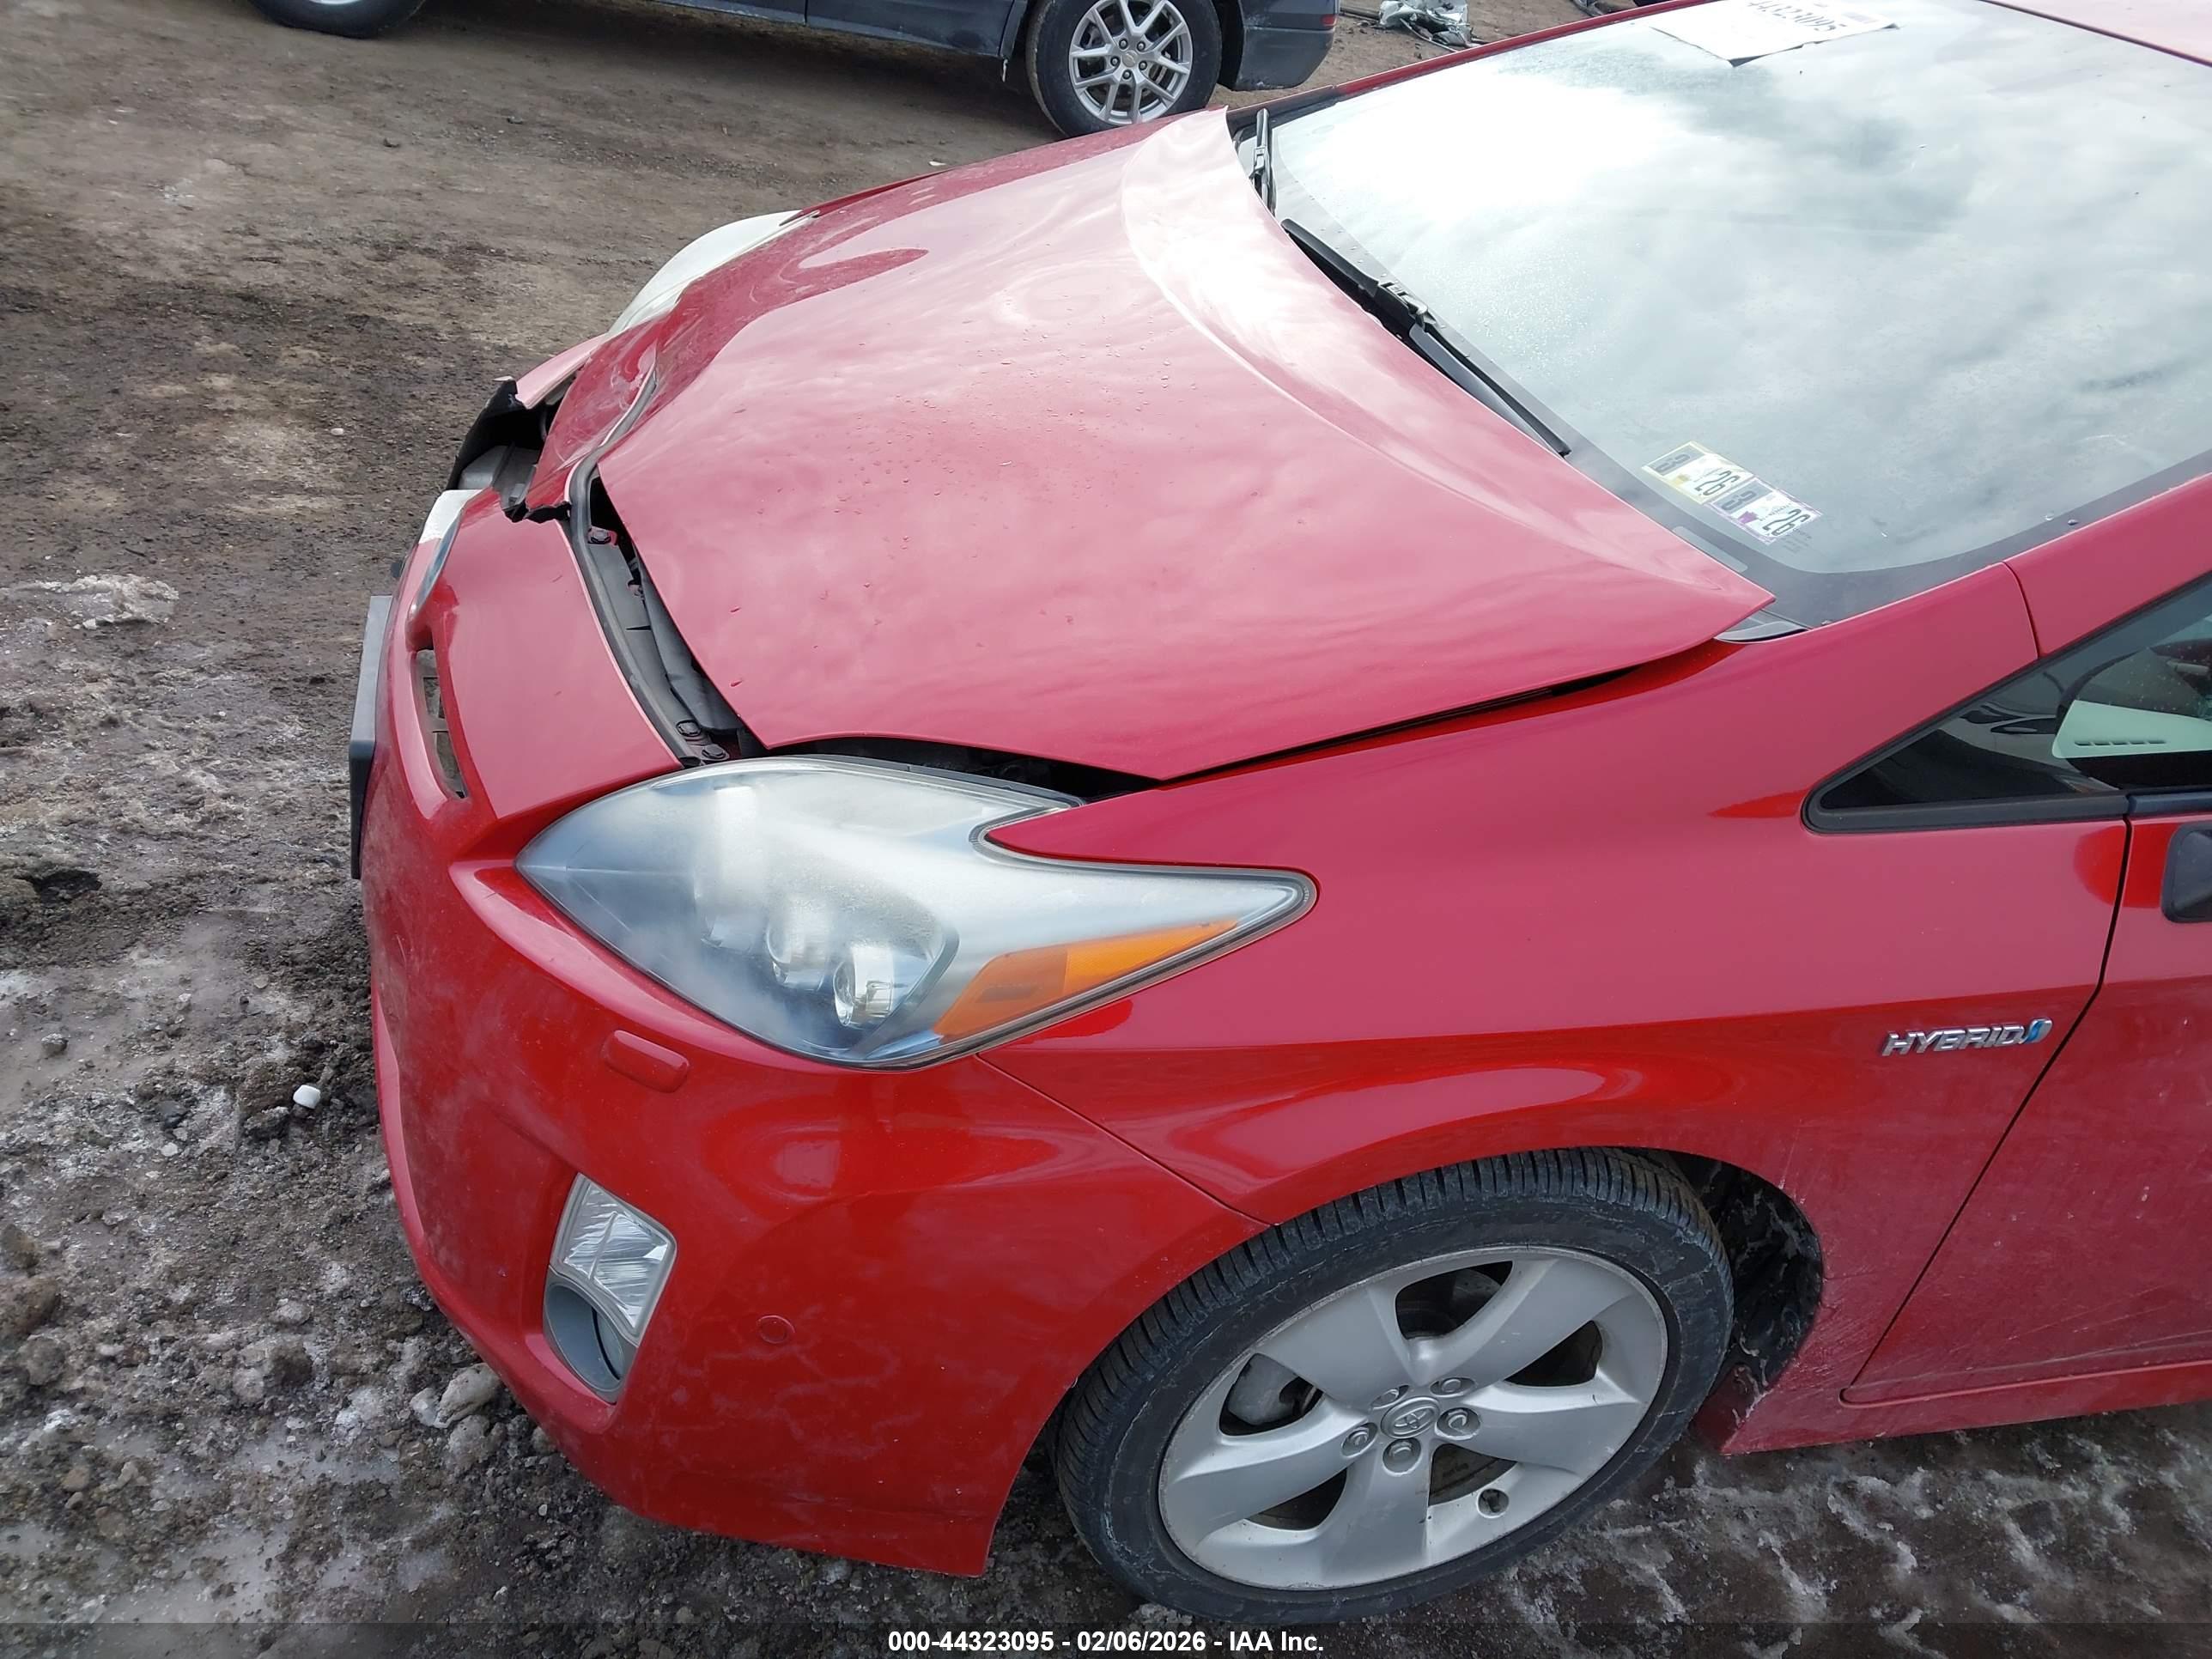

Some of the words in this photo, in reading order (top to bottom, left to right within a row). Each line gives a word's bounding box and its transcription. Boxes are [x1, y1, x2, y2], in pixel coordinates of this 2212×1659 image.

[1694, 470, 1740, 496] 26
[1722, 490, 1757, 511] 3
[1762, 508, 1810, 536] 26
[1882, 1024, 2025, 1056] HYBRID
